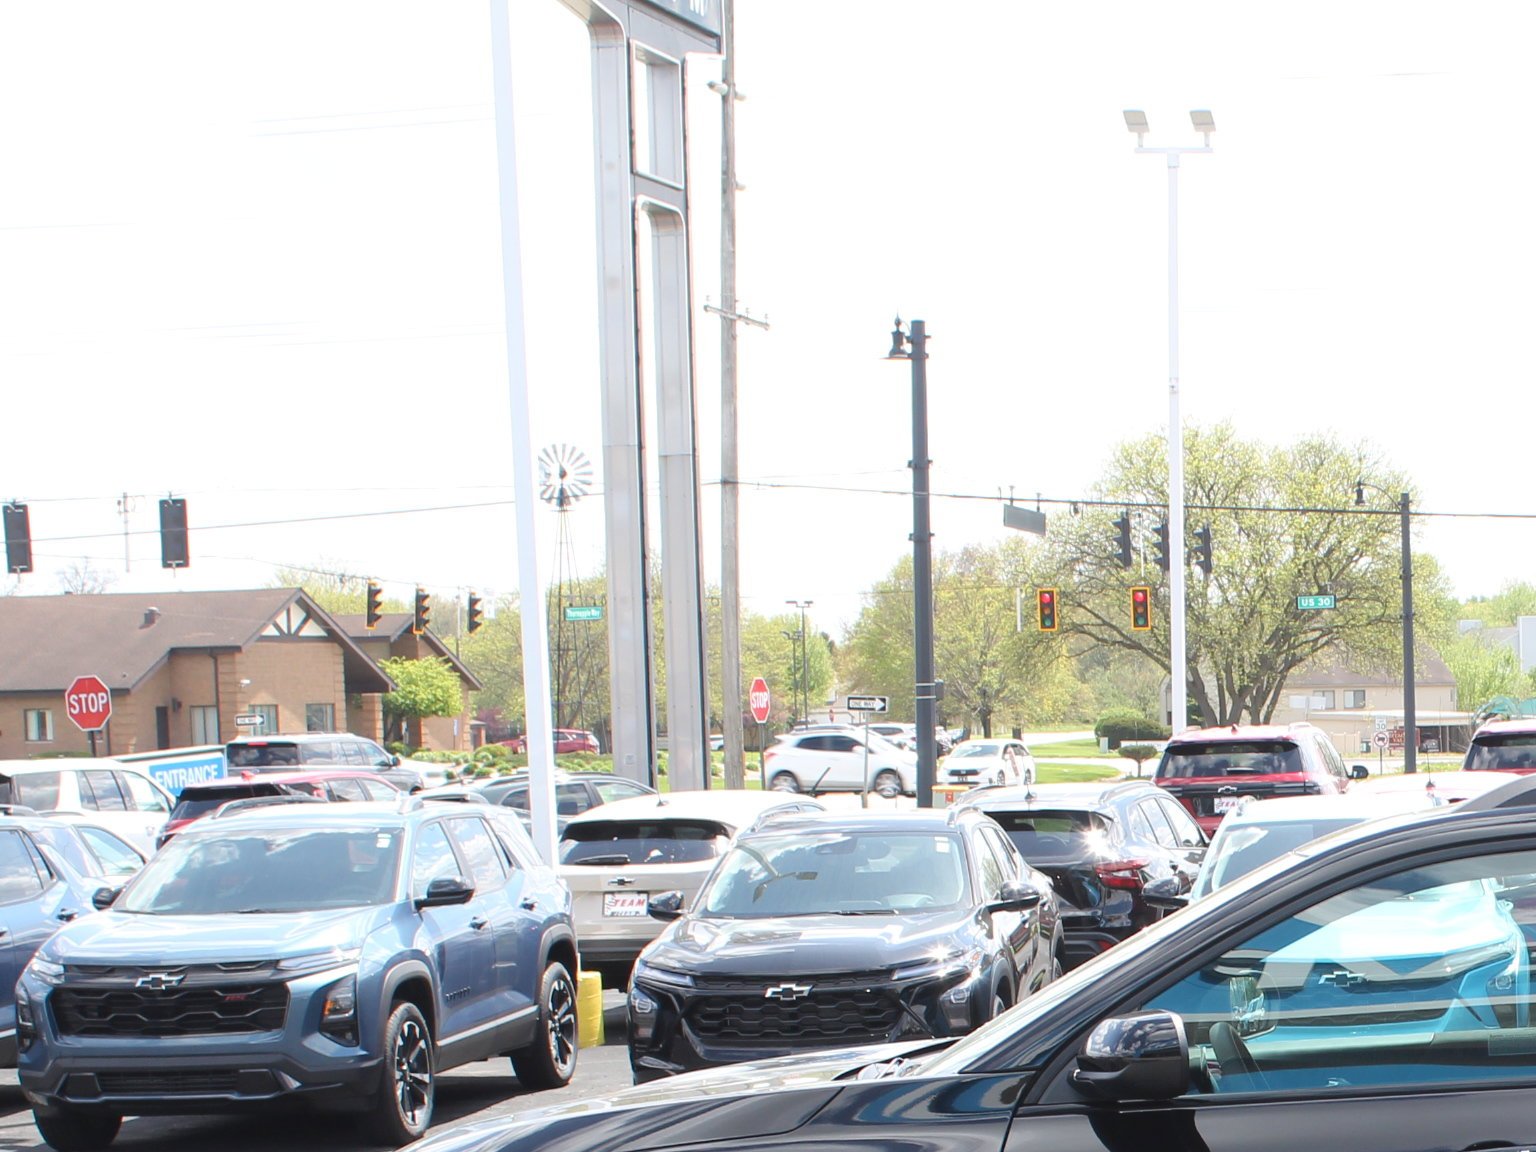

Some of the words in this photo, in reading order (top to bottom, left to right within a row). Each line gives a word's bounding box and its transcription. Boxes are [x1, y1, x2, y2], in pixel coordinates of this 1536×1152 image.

[1301, 598, 1315, 607] US
[1318, 597, 1331, 606] 30
[69, 692, 108, 714] STOP
[751, 691, 769, 708] STOP
[155, 764, 219, 789] ENTRANCE
[614, 899, 646, 907] TEAM
